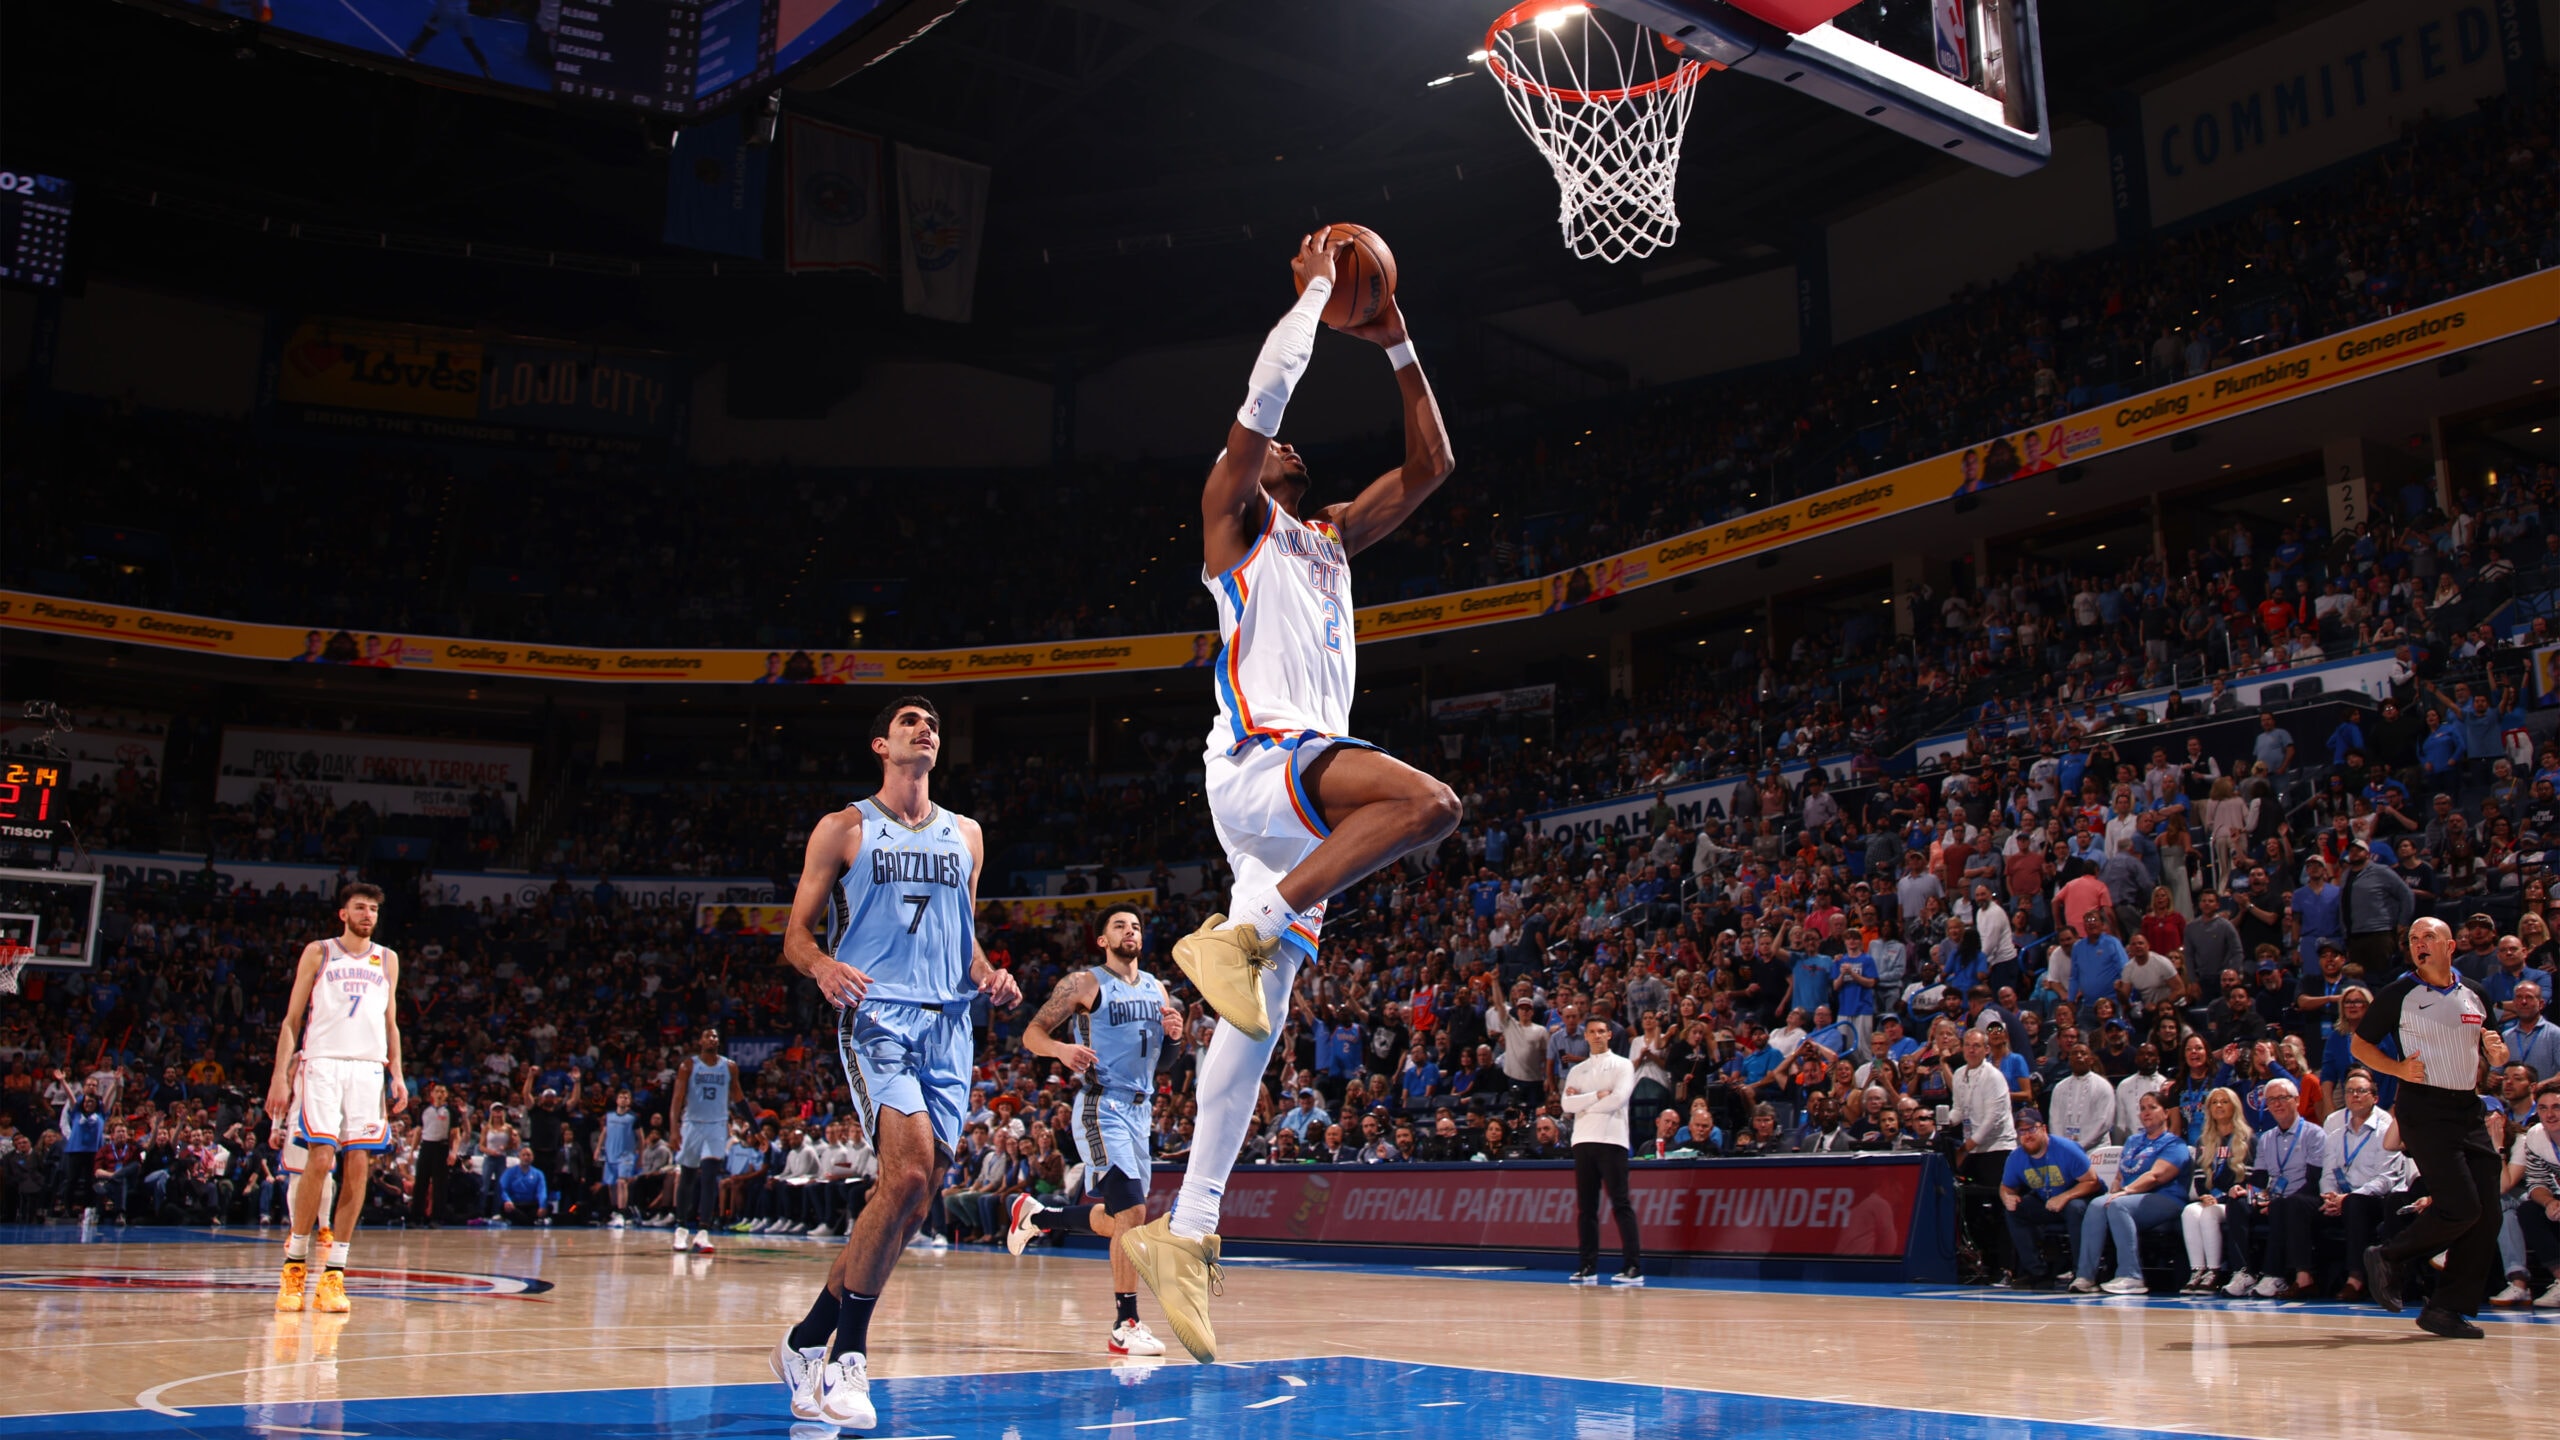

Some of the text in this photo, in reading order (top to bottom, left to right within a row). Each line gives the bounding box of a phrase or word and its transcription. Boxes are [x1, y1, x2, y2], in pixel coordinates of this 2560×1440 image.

[557, 43, 599, 59] JACKSON
[1940, 49, 1957, 71] NBA
[2162, 5, 2491, 178] COMMITTED
[2113, 153, 2128, 210] 322
[2115, 391, 2190, 428] Cooling
[2213, 357, 2311, 400] Plumbing
[2337, 311, 2466, 363] Generators
[591, 363, 664, 425] CITY
[304, 410, 368, 429] BRING
[375, 416, 413, 434] THE
[421, 420, 516, 443] THUNDER
[2340, 465, 2354, 521] 222
[1657, 537, 1710, 565] Cooling
[1723, 513, 1791, 545] Plumbing
[1806, 483, 1894, 519] Generators
[1322, 598, 1342, 654] 2
[1378, 588, 1543, 626] Plumbing Generators
[33, 602, 118, 629] Plumbing
[137, 616, 234, 642] Generators
[446, 644, 508, 663] Cooling
[526, 651, 601, 670] Plumbing
[617, 655, 703, 670] Generators
[897, 656, 952, 672] Cooling
[968, 651, 1034, 668] Plumbing
[1049, 645, 1132, 663] Generators
[7, 763, 59, 787] 2:14
[252, 749, 511, 783] POST OAK PARTY TERRACE
[413, 791, 441, 805] POST
[1, 825, 54, 840] TISSOT
[1554, 797, 1726, 845] OKLAHMA
[872, 848, 960, 889] GRIZZLIES
[903, 894, 931, 934] 7
[325, 968, 384, 987] OKLAHOMA
[343, 981, 368, 994] CITY
[349, 994, 362, 1017] 7
[1139, 1029, 1148, 1058] 1
[702, 1087, 717, 1100] 13
[1343, 1187, 1449, 1221] OFFICIAL
[1454, 1188, 1577, 1225] PARTNER
[1630, 1188, 1689, 1226] THE
[1695, 1187, 1855, 1228] THUNDER
